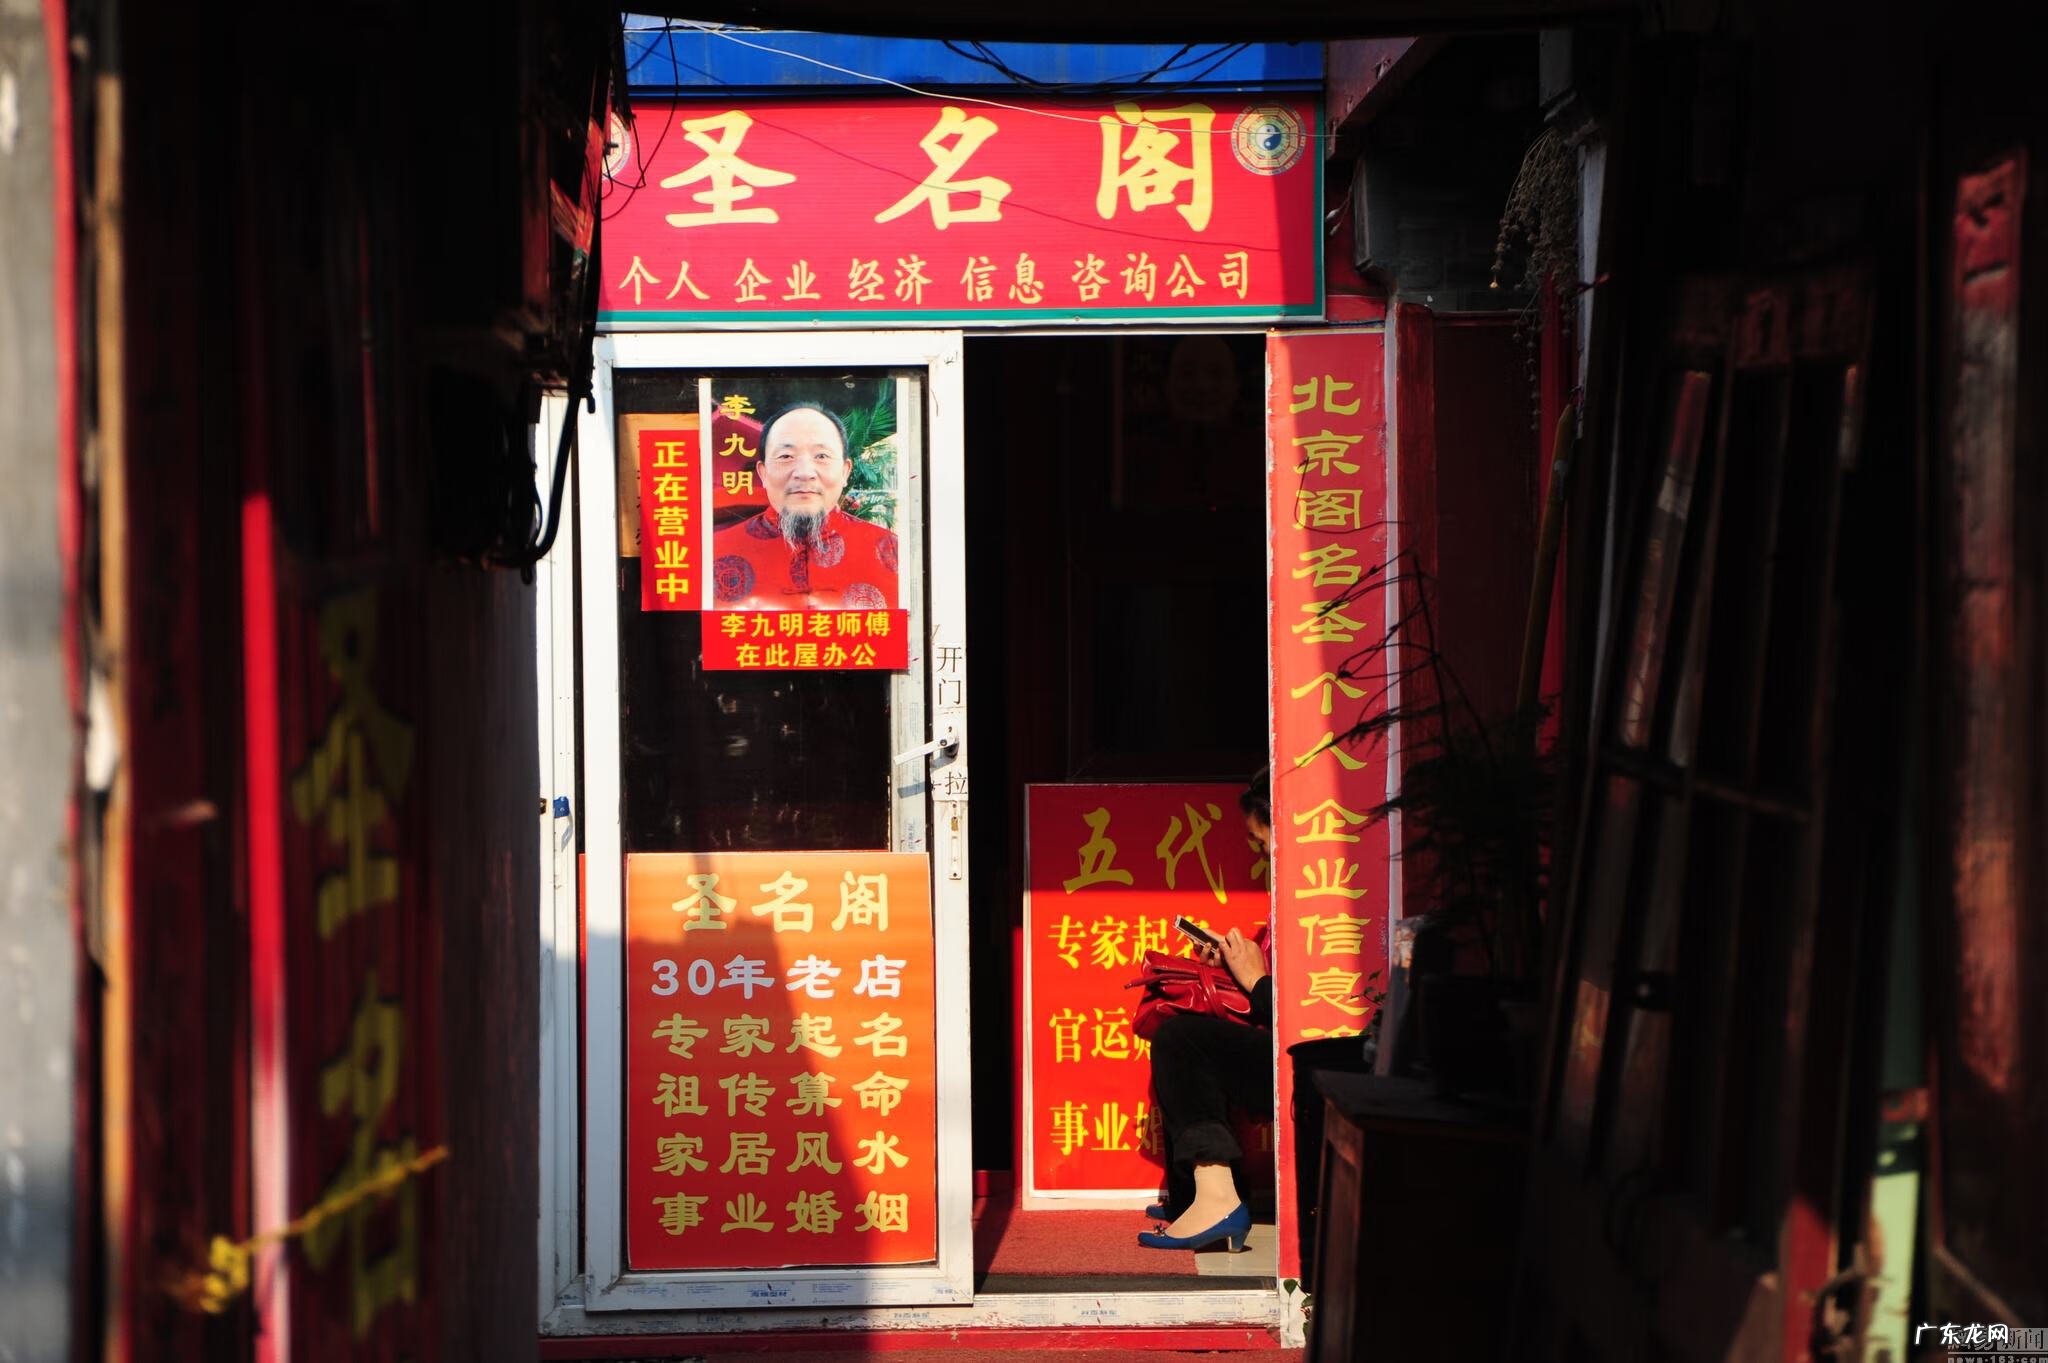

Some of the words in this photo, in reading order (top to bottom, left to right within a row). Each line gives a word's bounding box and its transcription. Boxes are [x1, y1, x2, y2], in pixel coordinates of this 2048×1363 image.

[660, 103, 1217, 232] 圣名阁
[719, 394, 757, 496] 李九明
[652, 441, 690, 603] 正在营业中
[721, 612, 891, 638] 李九明老师傅
[735, 642, 877, 668] 在此屋办公
[936, 646, 963, 705] 开门
[1289, 374, 1371, 1040] 北京阁名圣个人企业信息
[945, 771, 968, 796] 拉
[1062, 801, 1270, 905] 五代
[672, 870, 889, 933] 圣名阁
[651, 953, 908, 1000] 30年老店
[652, 1011, 909, 1060] 专家起名
[1049, 1007, 1152, 1063] 官运
[652, 1070, 910, 1118] 祖传算命
[652, 1130, 910, 1176] 家居风水
[652, 1190, 909, 1236] 事业婚姻
